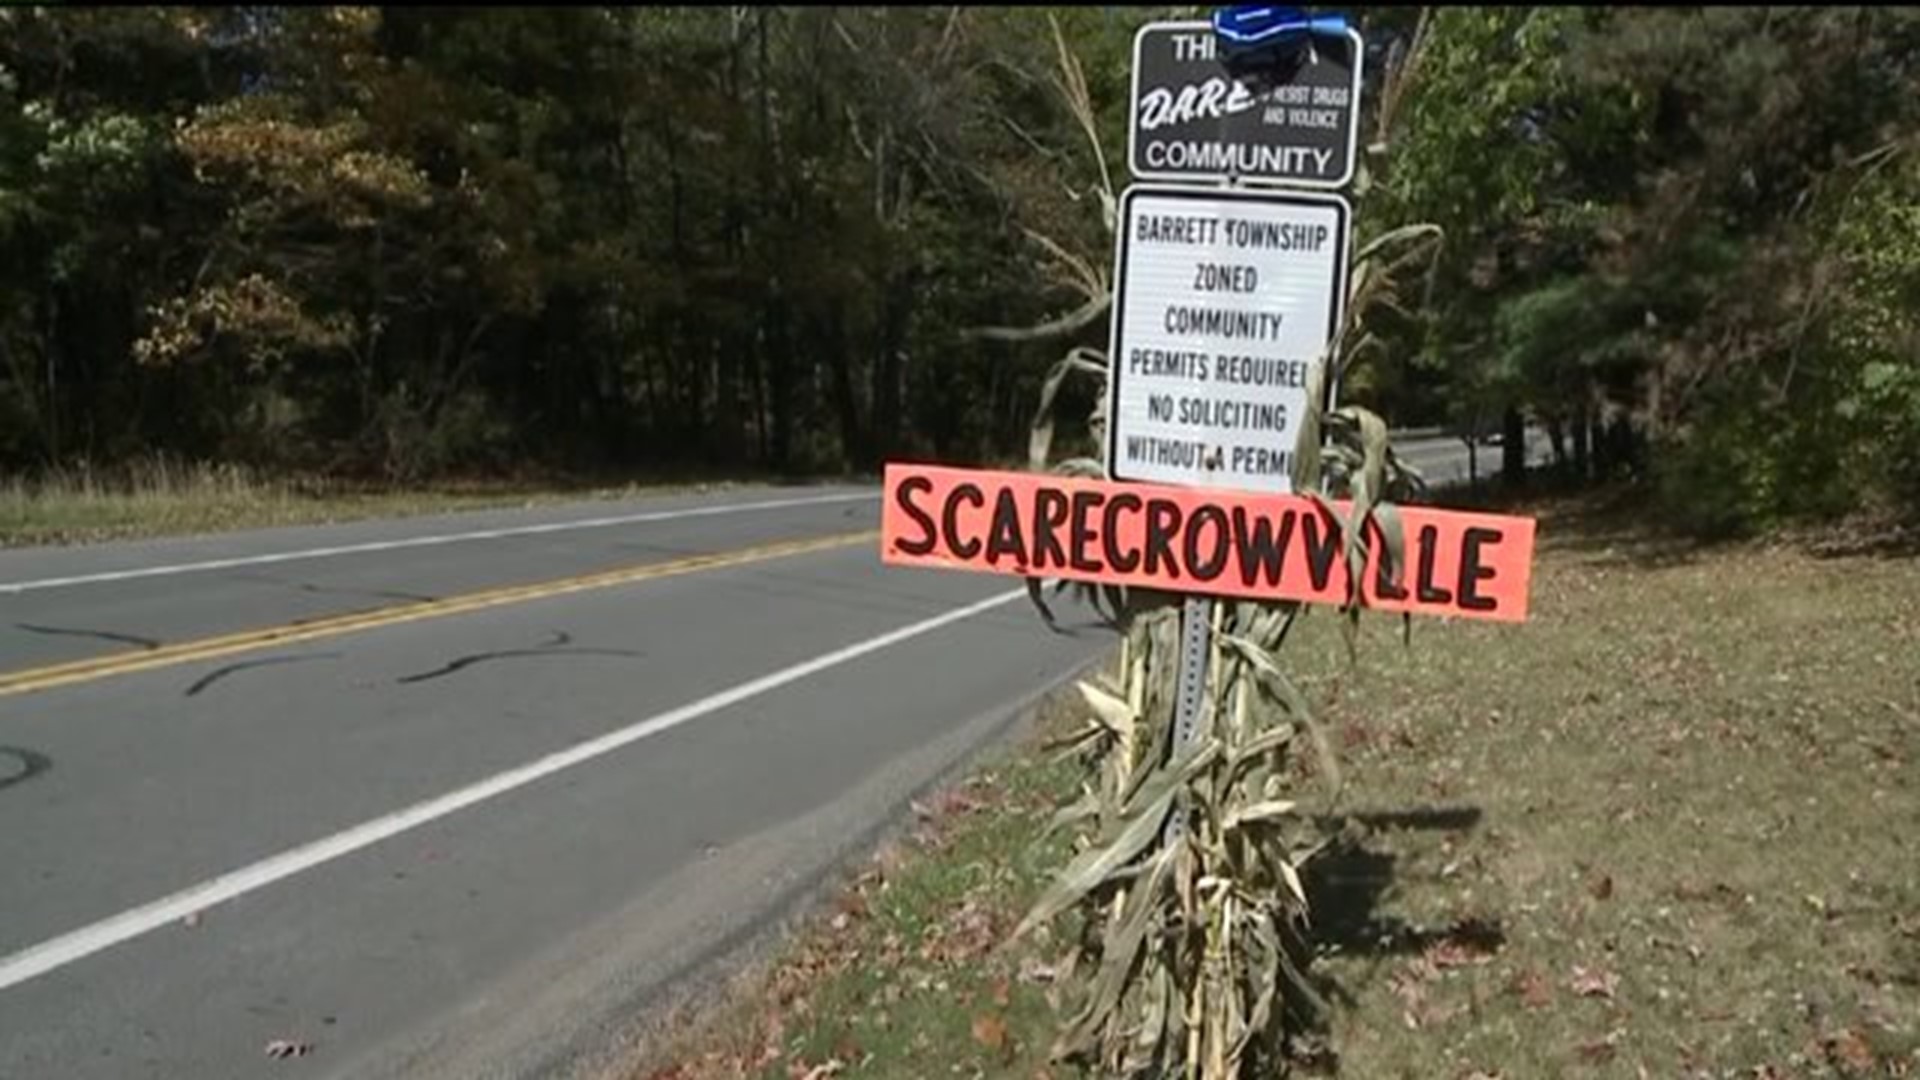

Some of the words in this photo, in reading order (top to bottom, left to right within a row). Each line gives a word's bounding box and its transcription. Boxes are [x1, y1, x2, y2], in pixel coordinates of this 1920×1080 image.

[1172, 34, 1217, 60] THI
[1274, 86, 1310, 104] RESIST
[1313, 87, 1349, 106] DRUGS
[1262, 106, 1286, 126] AND
[1289, 108, 1339, 129] VIOLENCE
[1146, 140, 1333, 174] COMMUNITY
[1137, 214, 1219, 244] BARRETT
[1224, 218, 1328, 251] TOWNSHIP
[1194, 263, 1258, 294] ZONED
[1165, 305, 1283, 341] COMMUNITY
[1130, 349, 1209, 381] PERMITS
[1148, 394, 1174, 423] NO
[1178, 396, 1287, 432] SOLICITING
[1126, 435, 1206, 470] WITHOUT
[1210, 446, 1225, 470] A
[895, 476, 1505, 612] SCARECROWVLLE
